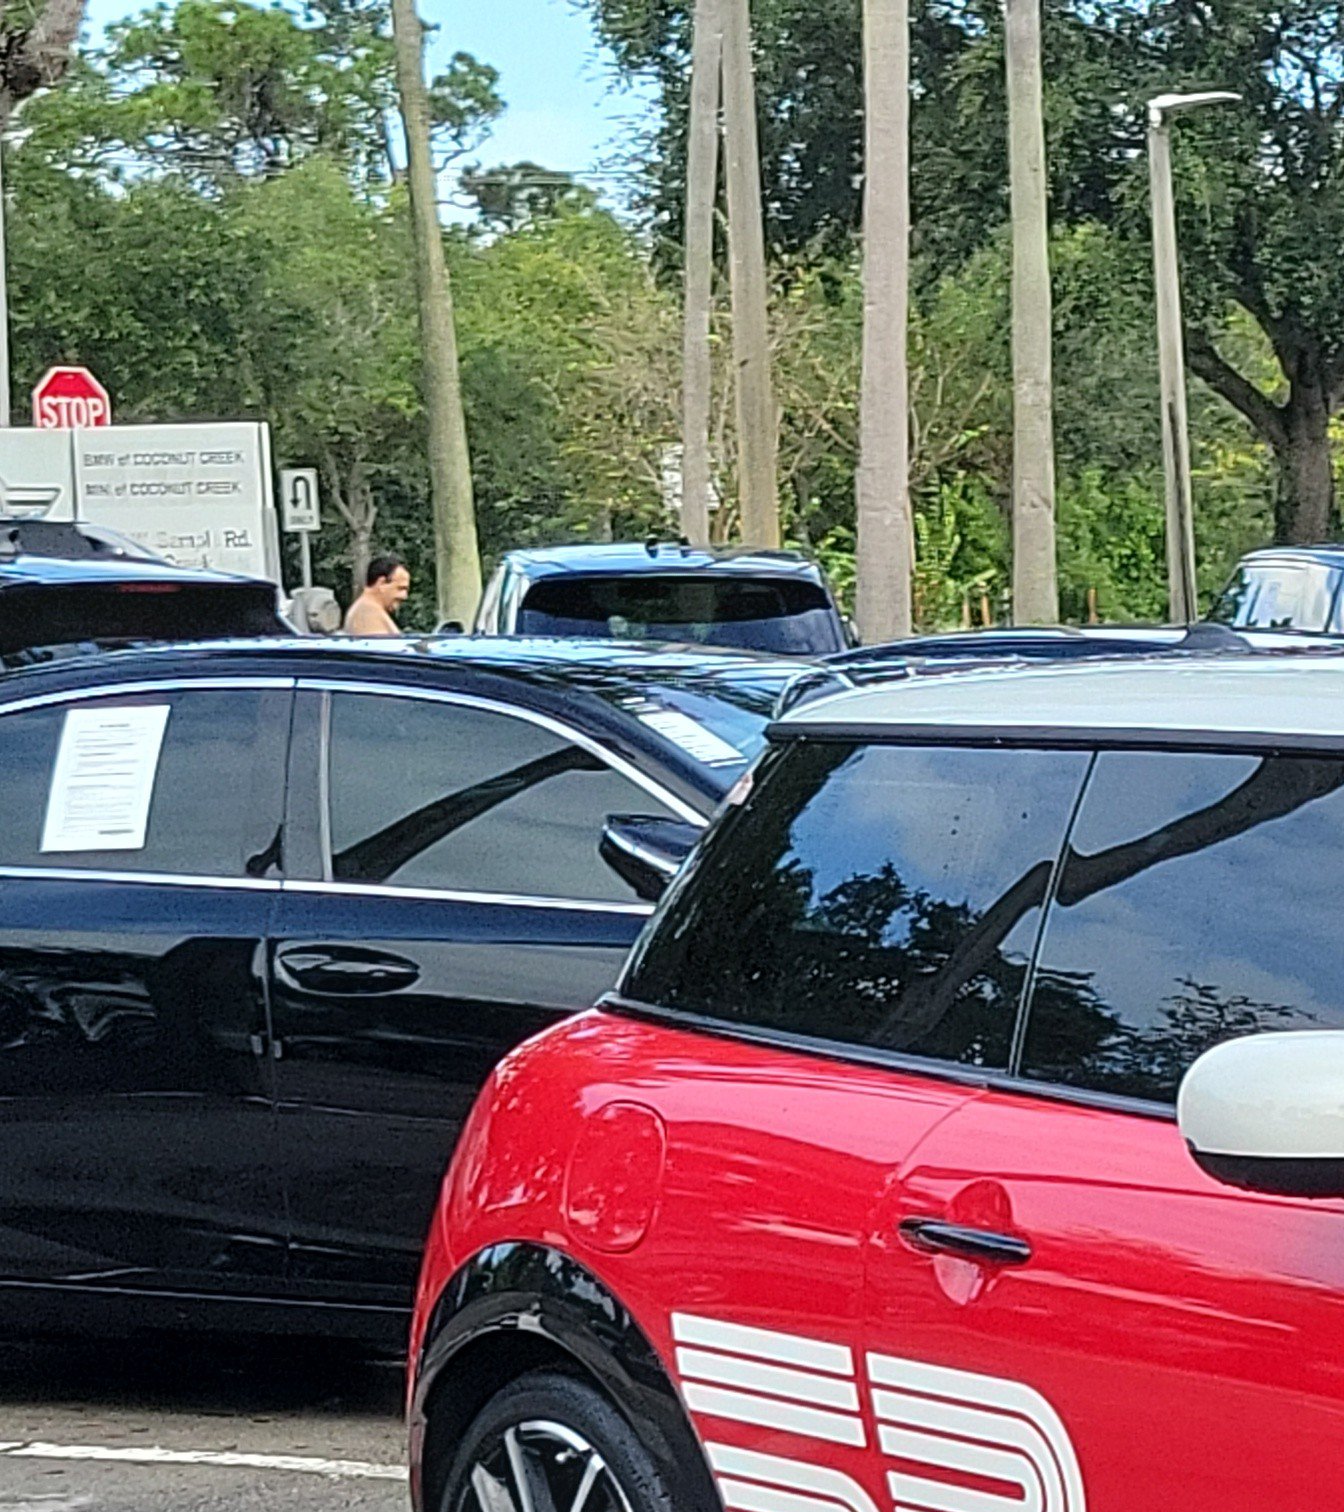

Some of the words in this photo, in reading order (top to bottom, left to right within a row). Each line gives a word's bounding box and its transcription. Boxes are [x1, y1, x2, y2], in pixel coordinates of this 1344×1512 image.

[41, 396, 104, 428] STOP
[133, 452, 196, 466] COCONUT
[200, 451, 245, 465] CREEK
[130, 482, 193, 496] COCONUT
[196, 481, 242, 495] CREEK
[156, 530, 216, 549] Sampl
